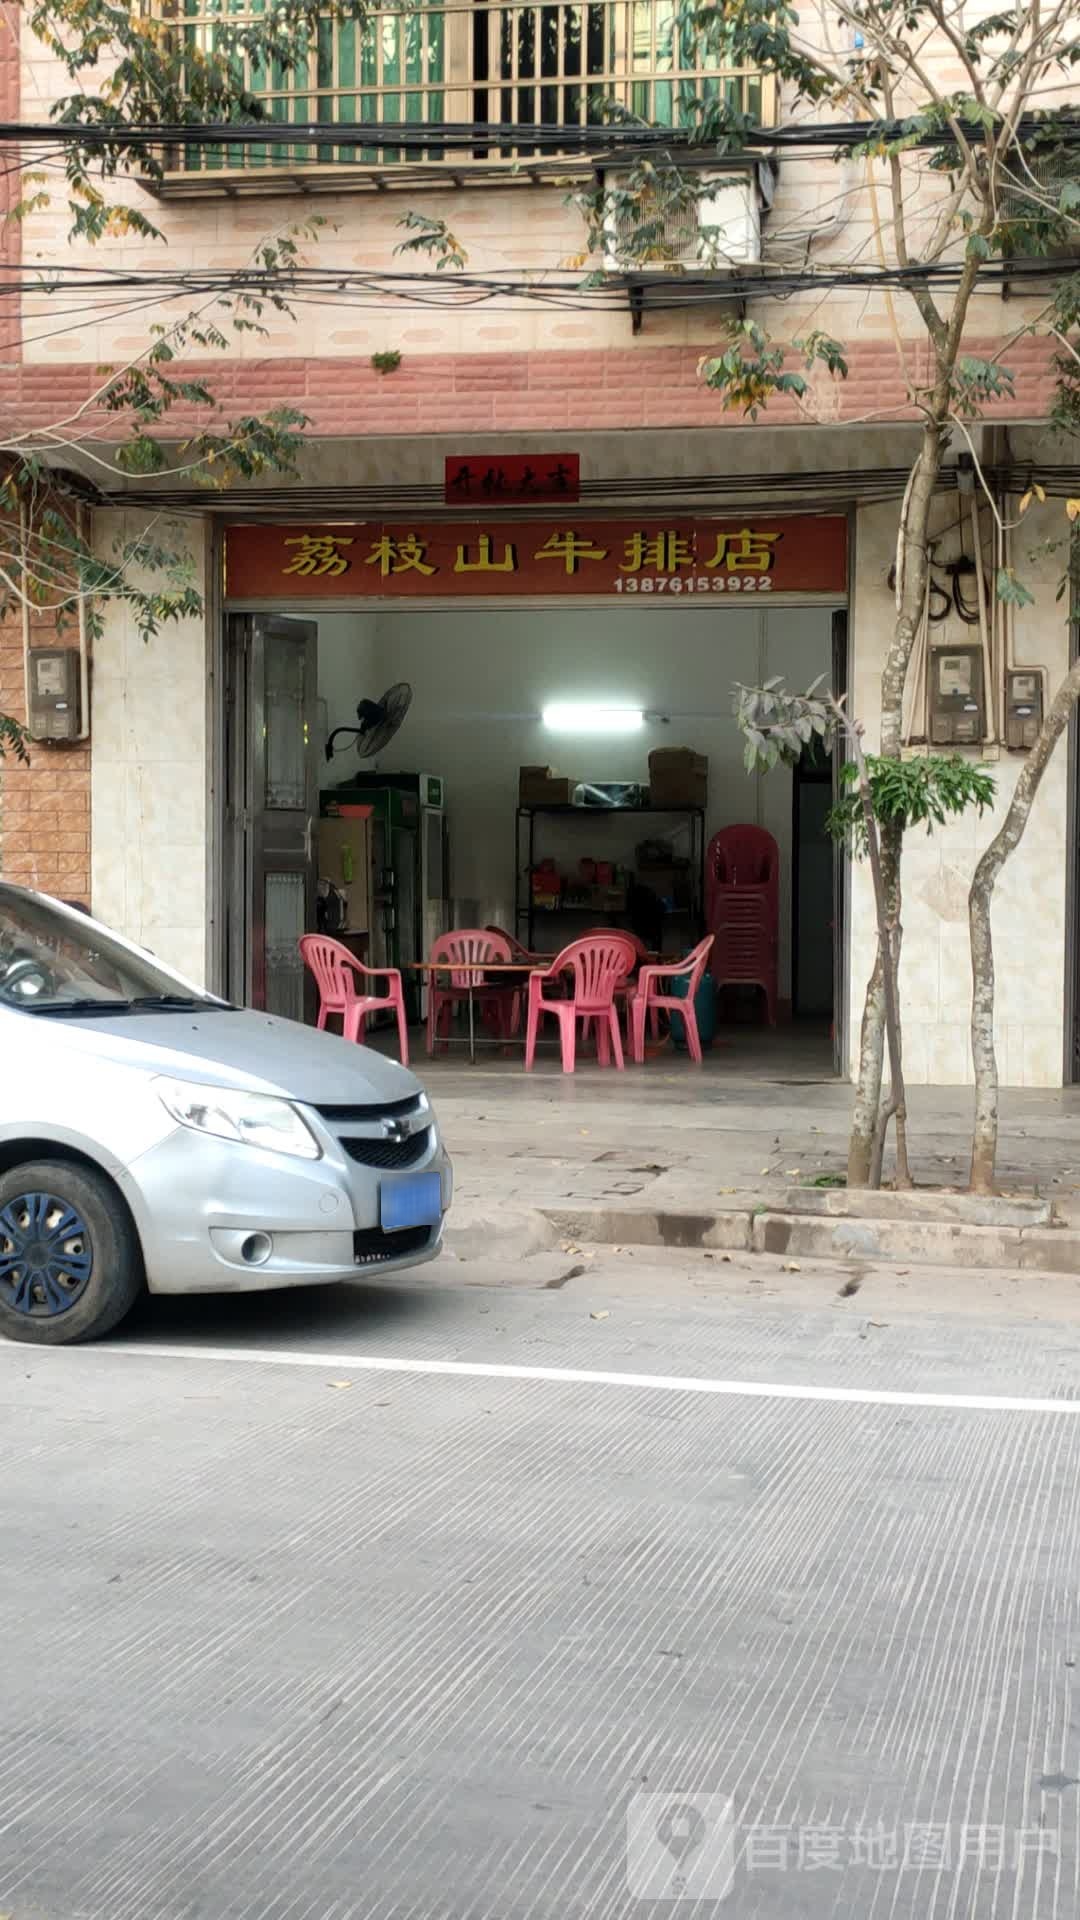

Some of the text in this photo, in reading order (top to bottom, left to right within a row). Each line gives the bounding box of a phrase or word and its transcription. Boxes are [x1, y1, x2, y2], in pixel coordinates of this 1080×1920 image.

[282, 528, 782, 576] 荔枝山牛排店
[613, 576, 773, 592] 13876153922
